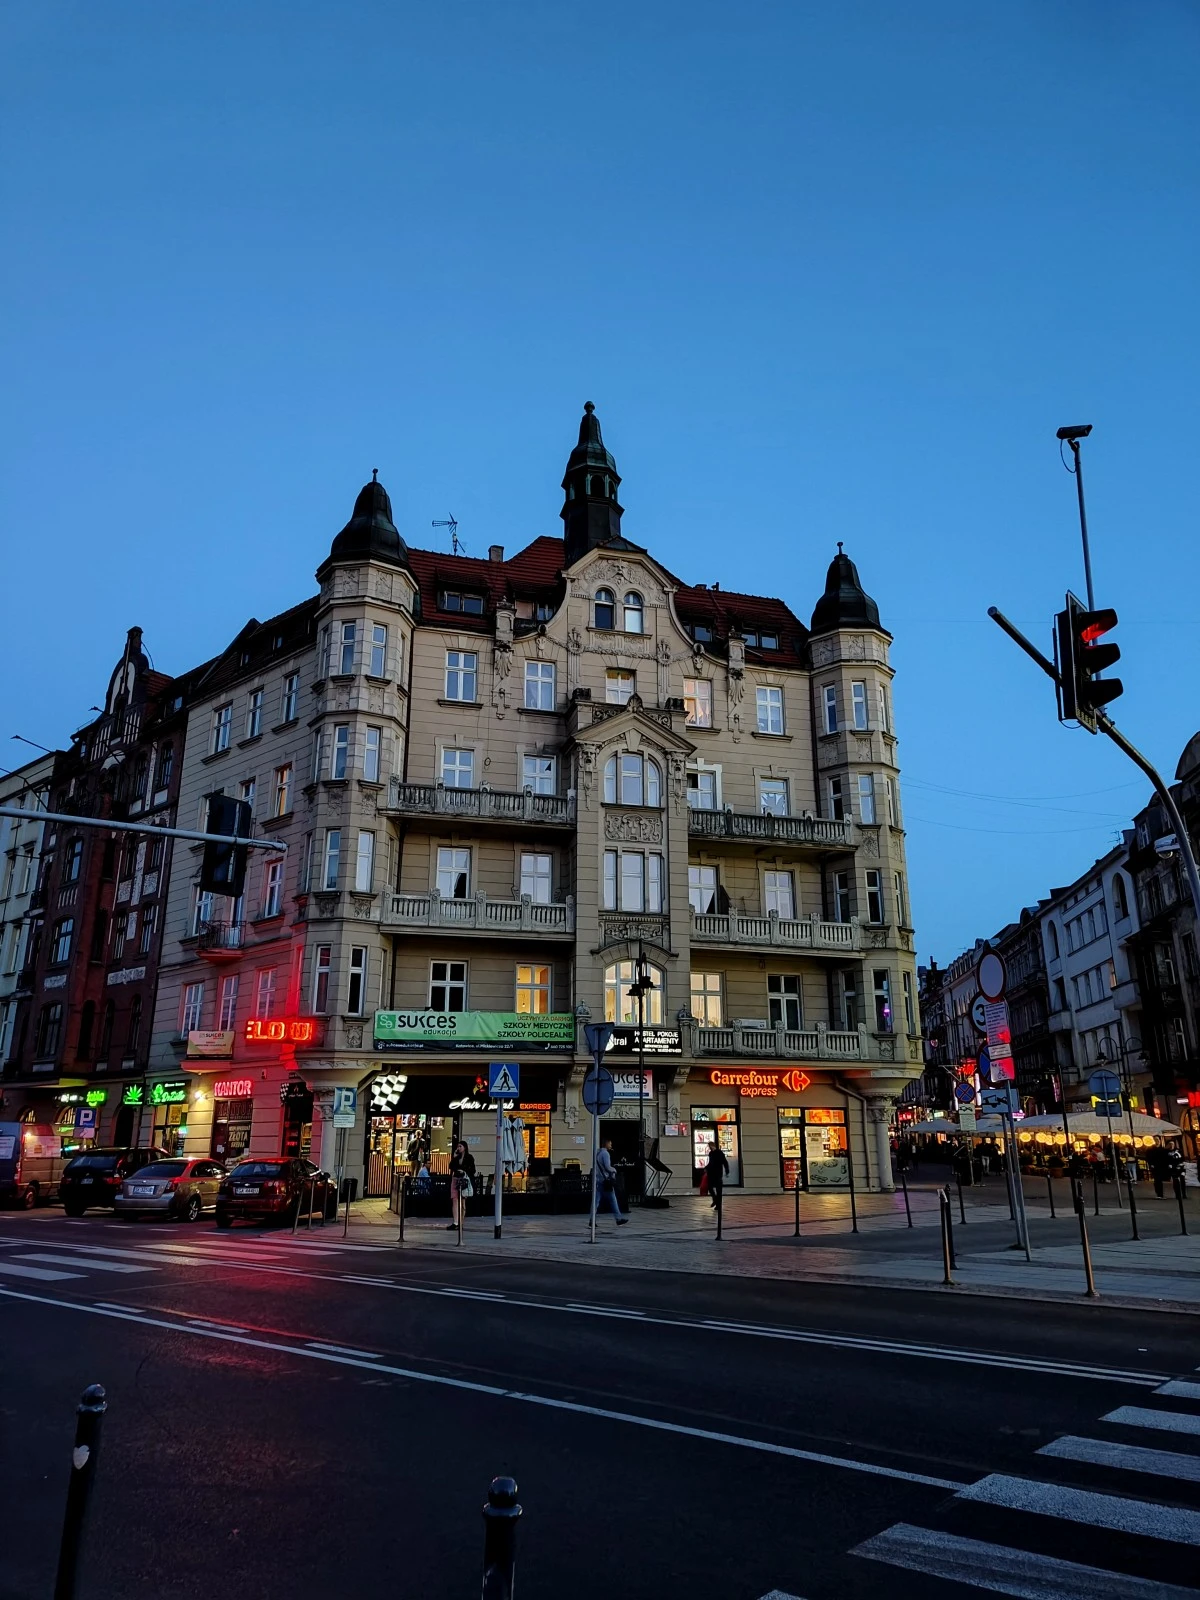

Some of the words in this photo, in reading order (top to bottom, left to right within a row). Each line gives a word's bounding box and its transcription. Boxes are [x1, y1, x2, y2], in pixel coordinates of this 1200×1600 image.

[423, 1029, 457, 1037] edukacja
[613, 1073, 648, 1084] ukces
[711, 1070, 778, 1085] Carrefour
[214, 1080, 252, 1096] KANTOR
[741, 1087, 778, 1098] express
[340, 1089, 354, 1111] P
[80, 1110, 93, 1126] P
